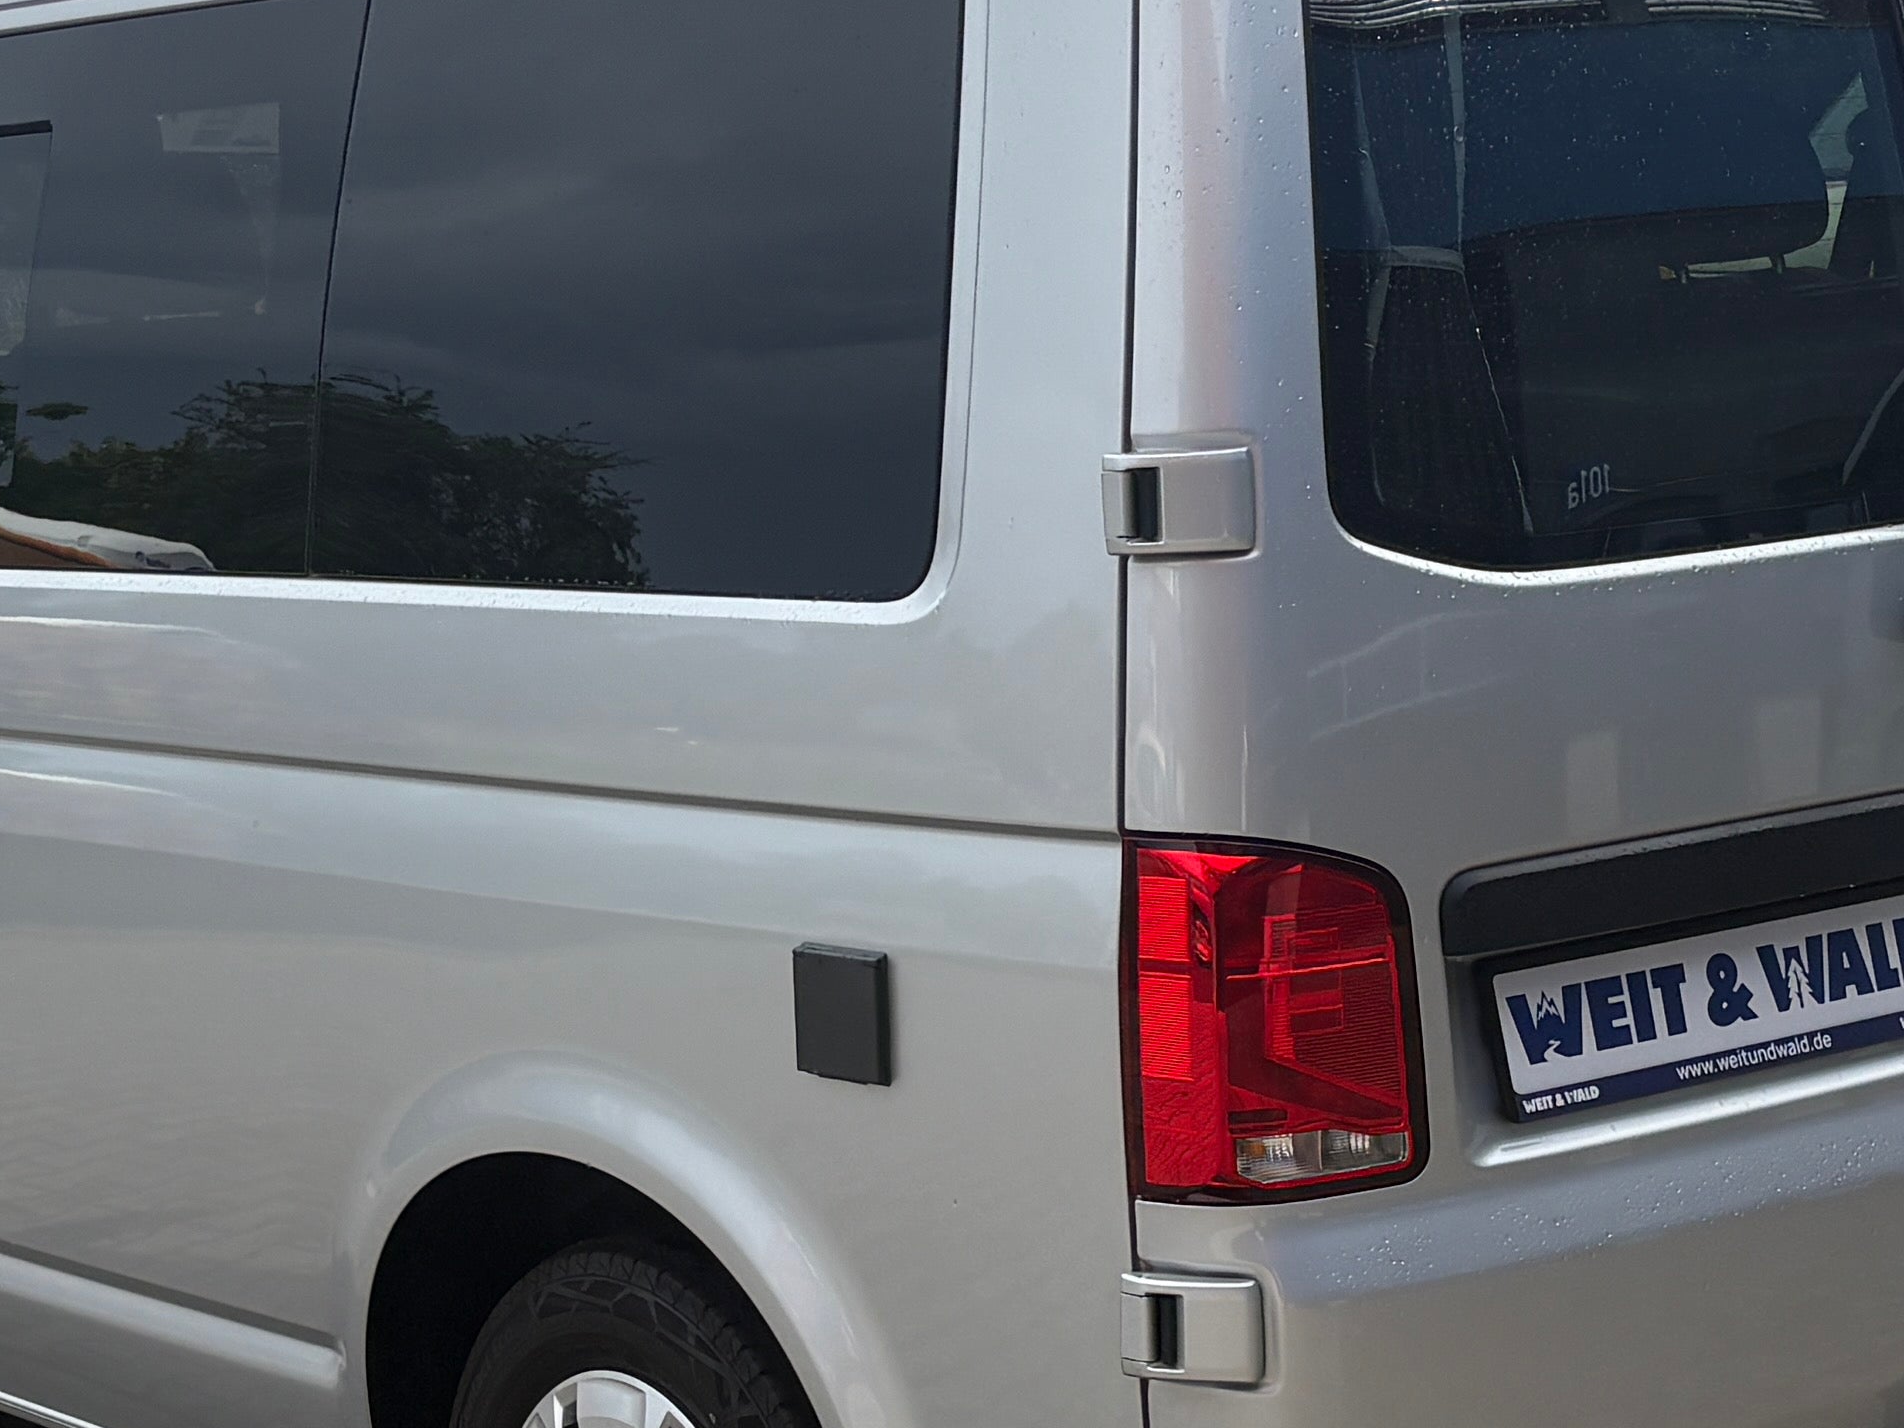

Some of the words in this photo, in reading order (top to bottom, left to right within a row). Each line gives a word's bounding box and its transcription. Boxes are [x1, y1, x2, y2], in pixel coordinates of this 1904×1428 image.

[1505, 963, 1688, 1066] WEIT
[1706, 952, 1758, 1028] &
[1676, 1032, 1833, 1081] www.weitundwald.de
[1522, 1095, 1554, 1114] WEIT
[1555, 1093, 1565, 1107] &
